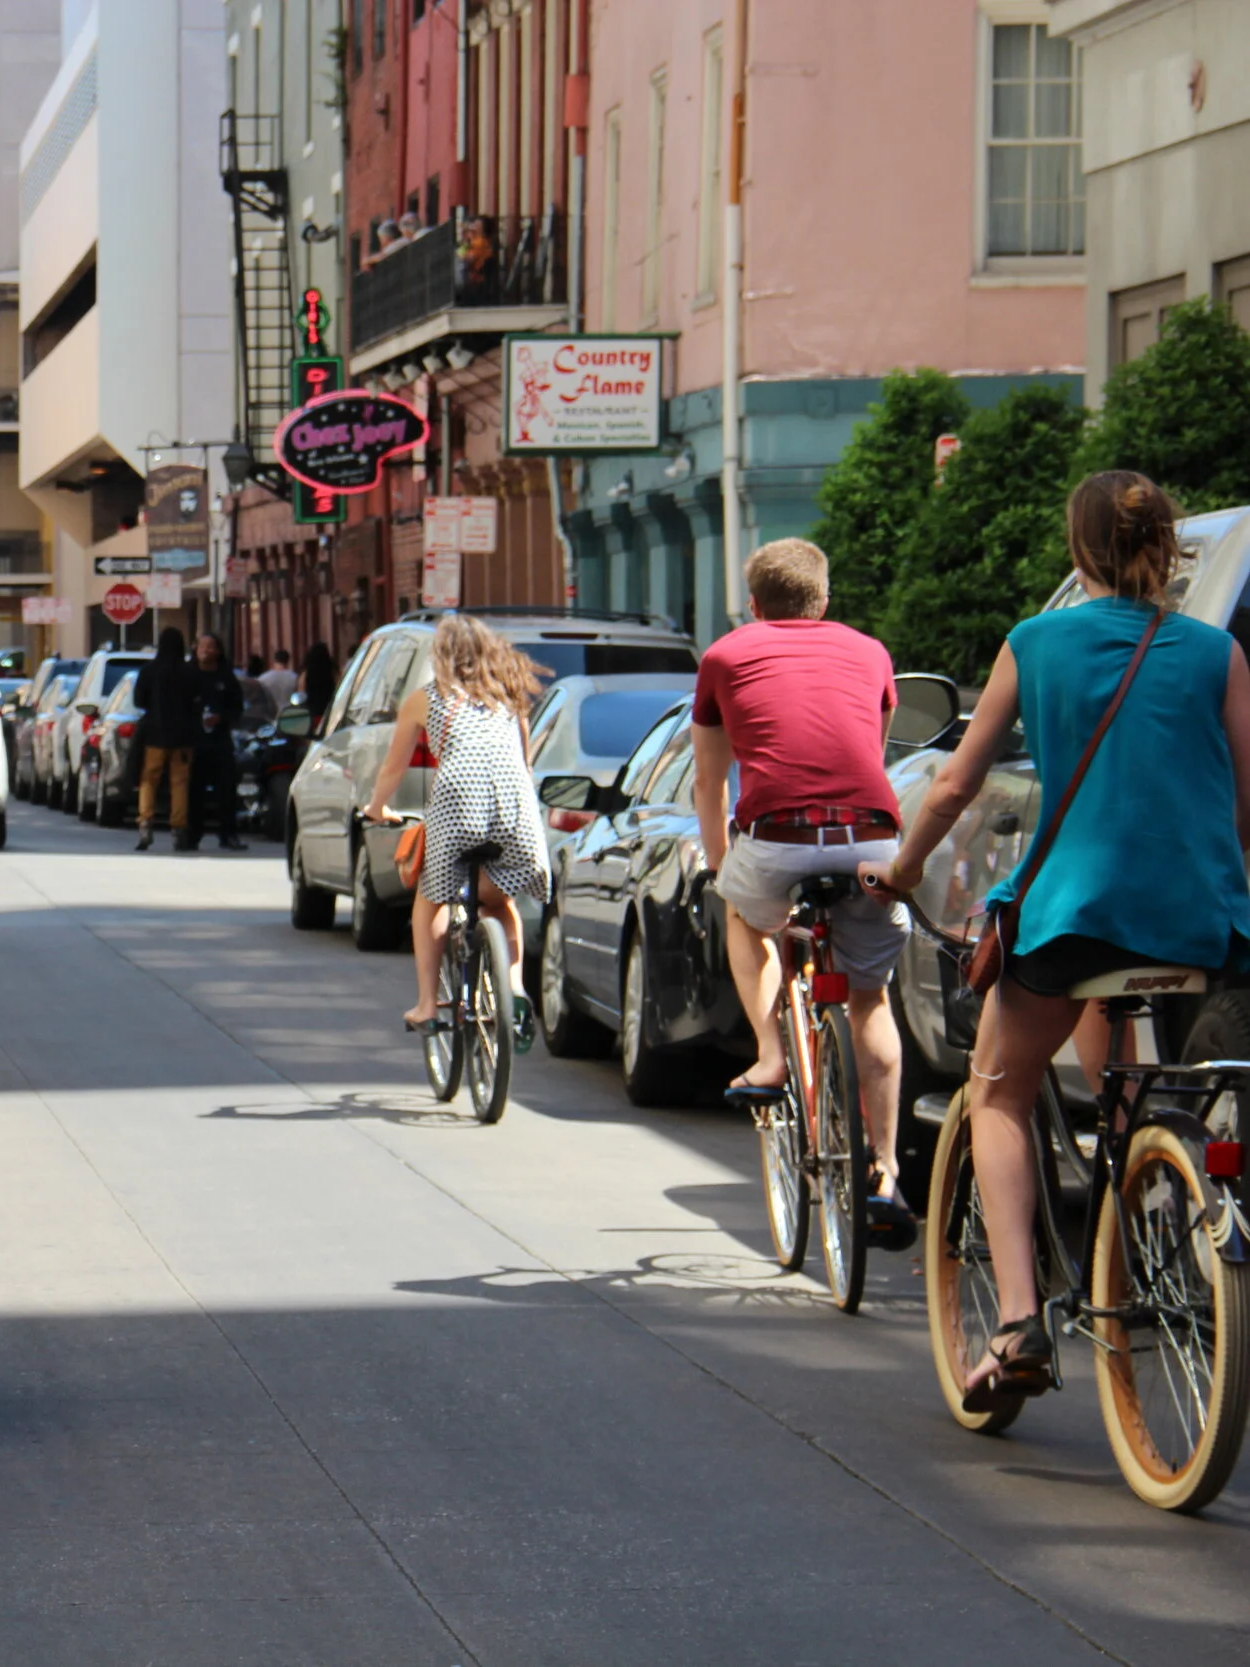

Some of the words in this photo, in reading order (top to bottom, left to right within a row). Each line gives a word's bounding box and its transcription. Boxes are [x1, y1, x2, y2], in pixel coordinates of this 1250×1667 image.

[553, 344, 652, 374] Country
[558, 373, 646, 403] Flame
[563, 406, 638, 416] RESTAURANT
[105, 594, 141, 610] STOP
